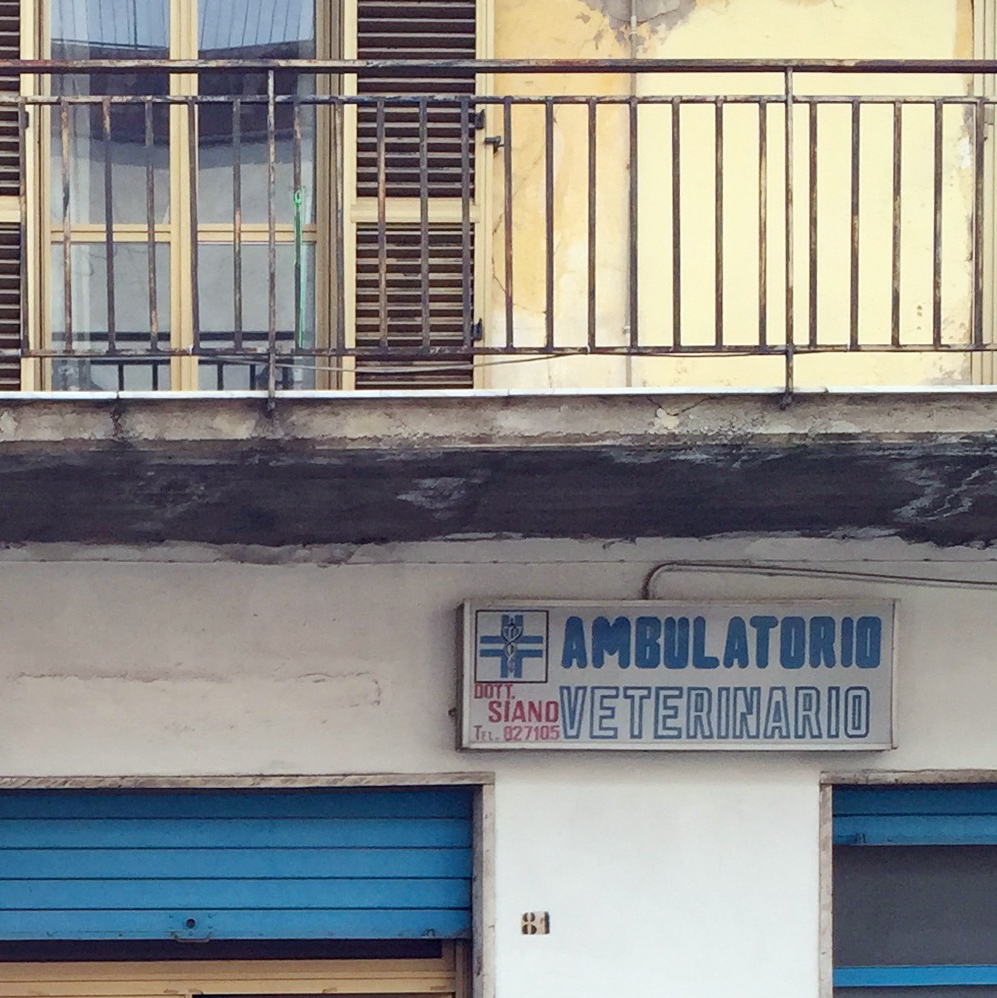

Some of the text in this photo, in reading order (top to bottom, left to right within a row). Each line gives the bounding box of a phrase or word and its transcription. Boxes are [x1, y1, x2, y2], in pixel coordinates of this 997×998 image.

[561, 615, 882, 670] AMBULATORIO
[488, 700, 559, 723] SIANO
[559, 685, 871, 740] VETERINARIO
[503, 725, 560, 741] 827105
[522, 911, 549, 935] 81
